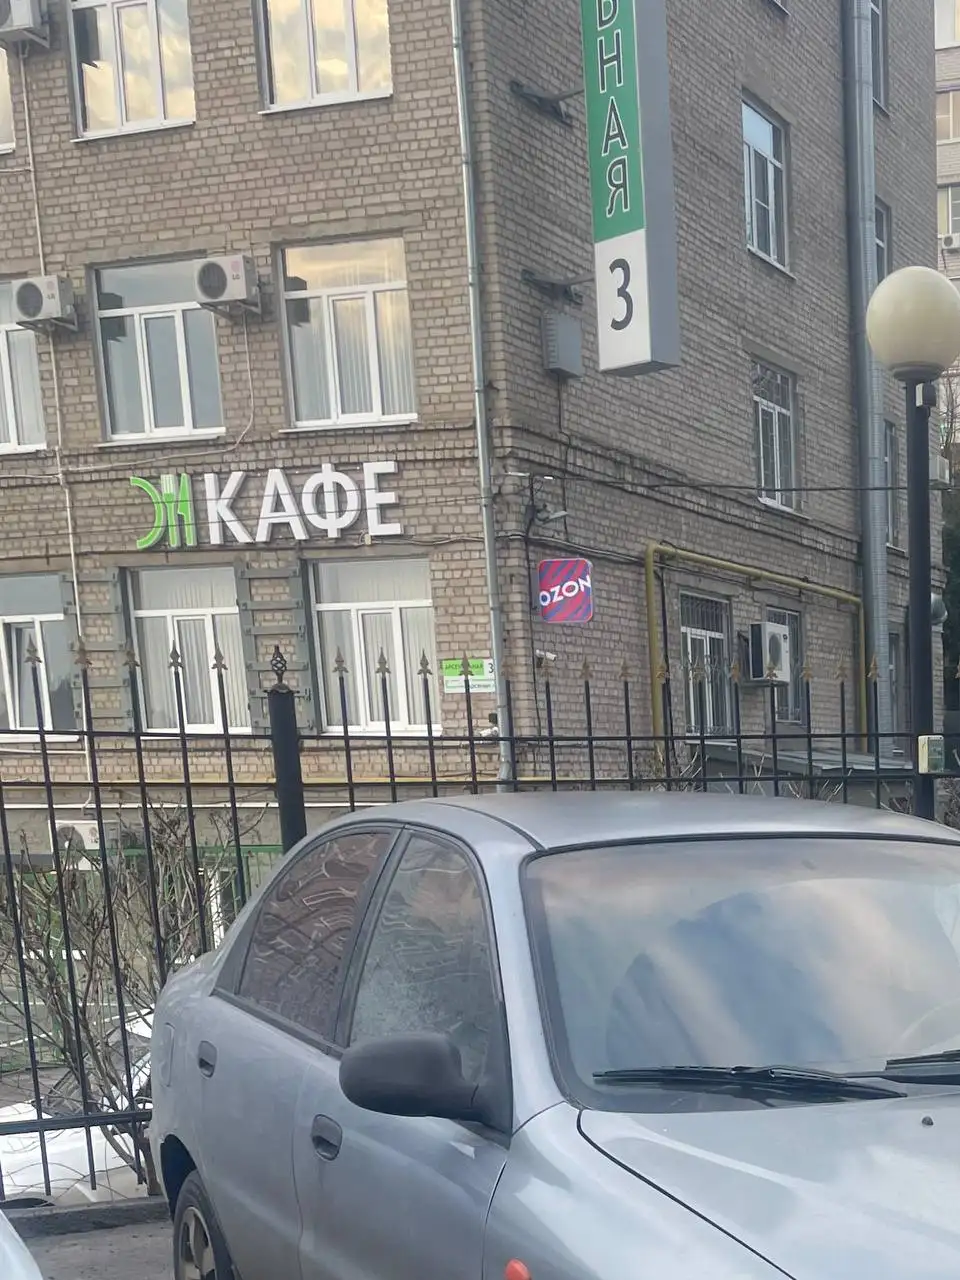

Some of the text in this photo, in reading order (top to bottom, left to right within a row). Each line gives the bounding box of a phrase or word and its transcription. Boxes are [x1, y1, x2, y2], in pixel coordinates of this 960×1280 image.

[608, 258, 634, 331] 3
[204, 461, 403, 545] КАФЕ
[539, 574, 592, 606] OZON
[488, 662, 495, 674] 3
